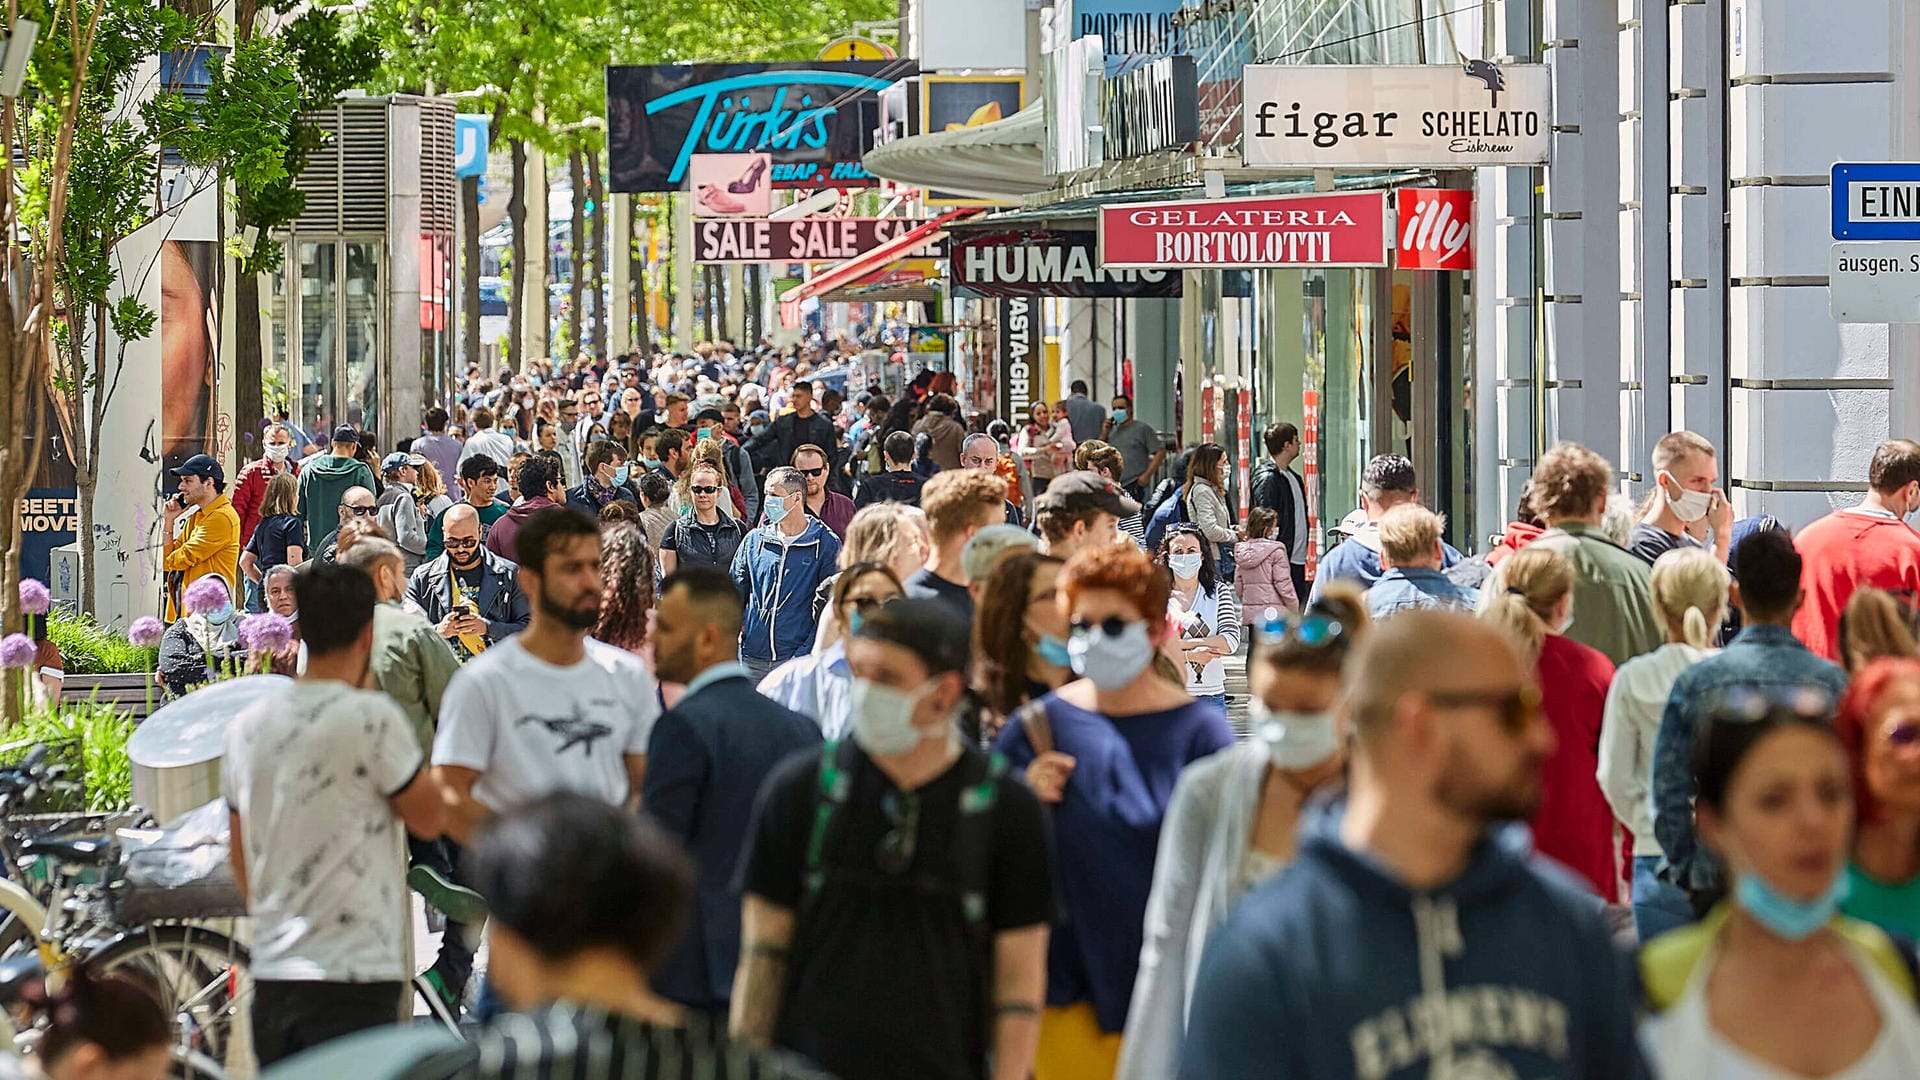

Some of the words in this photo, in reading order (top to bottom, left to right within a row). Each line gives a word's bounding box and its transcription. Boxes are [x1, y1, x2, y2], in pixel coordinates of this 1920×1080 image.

[645, 70, 895, 183] Türkis
[1255, 102, 1398, 148] figar
[1422, 111, 1539, 137] SCHELATO
[1448, 138, 1514, 153] Eiskrem
[770, 163, 818, 181] EBAP
[1861, 186, 1920, 217] EIN
[1129, 210, 1357, 227] GELATERIA
[1402, 199, 1470, 264] illy
[702, 221, 770, 259] SALE
[789, 221, 857, 259] SALE
[1155, 231, 1332, 263] BORTOLOTTI
[1838, 257, 1904, 276] ausgen.
[20, 498, 78, 515] BEET
